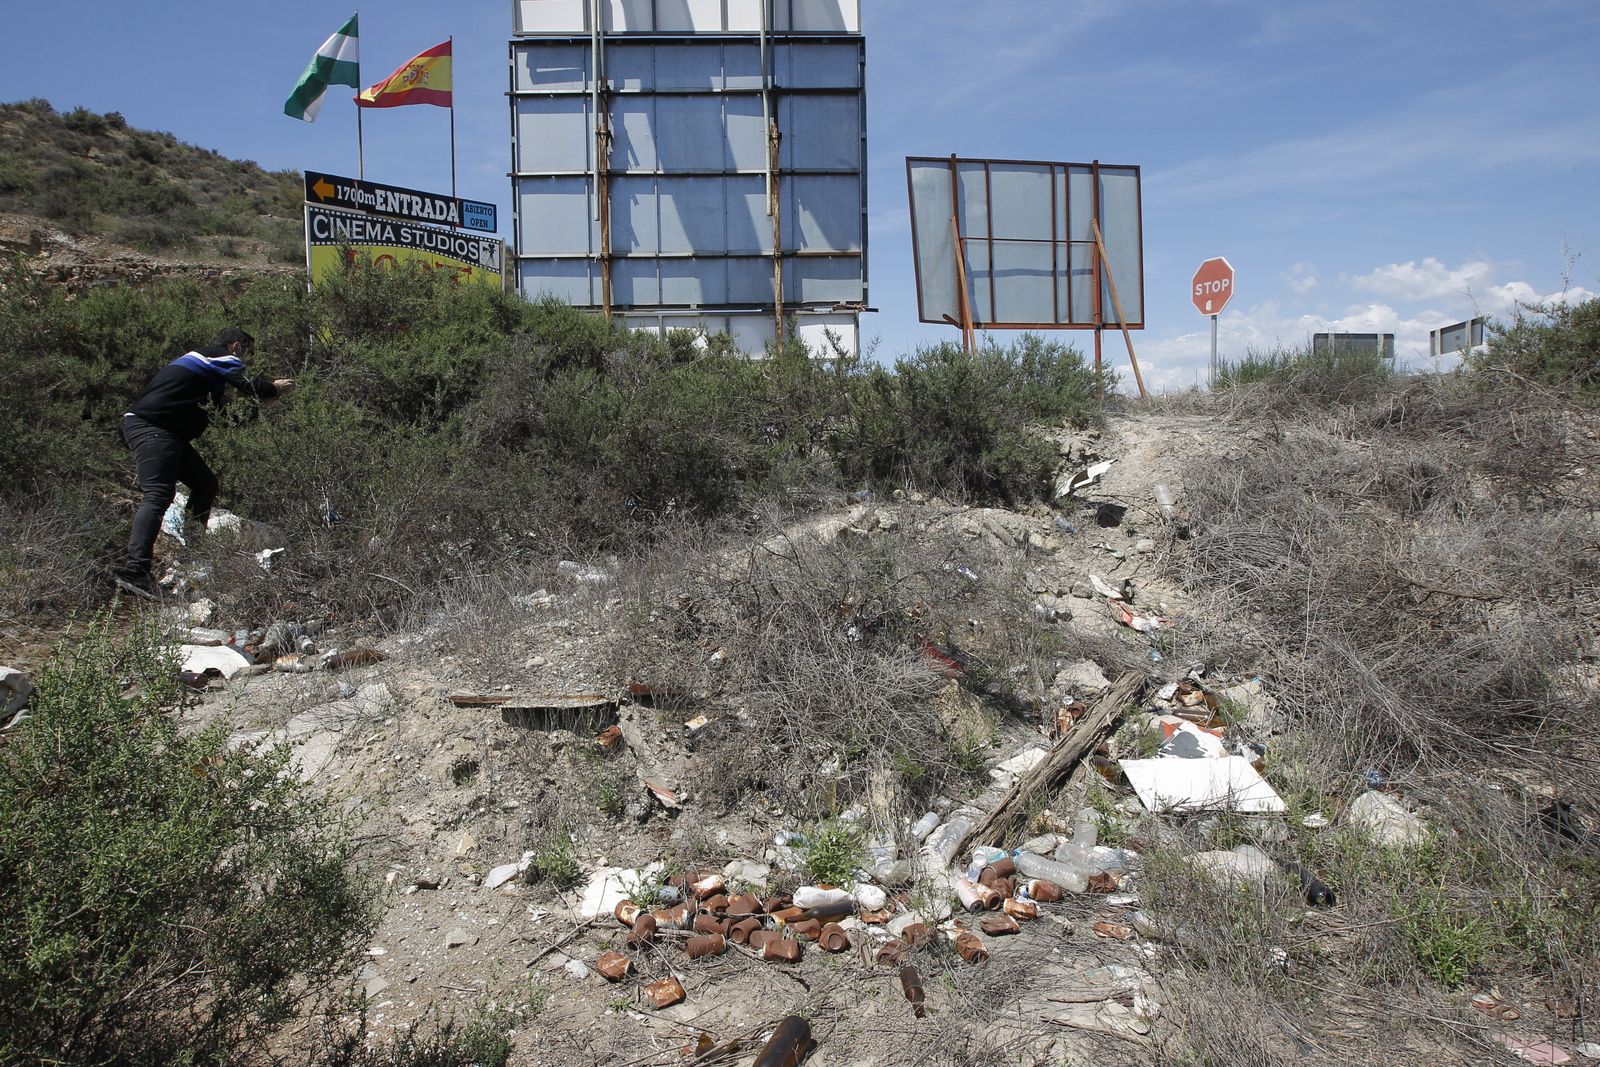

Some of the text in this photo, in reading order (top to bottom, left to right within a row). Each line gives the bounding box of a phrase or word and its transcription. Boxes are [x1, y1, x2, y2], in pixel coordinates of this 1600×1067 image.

[375, 189, 460, 223] ENTRADA
[464, 204, 493, 216] ABIERTO
[470, 217, 488, 228] OPEN
[313, 214, 479, 260] CINEMA STUDIOS
[1195, 278, 1230, 296] STOP
